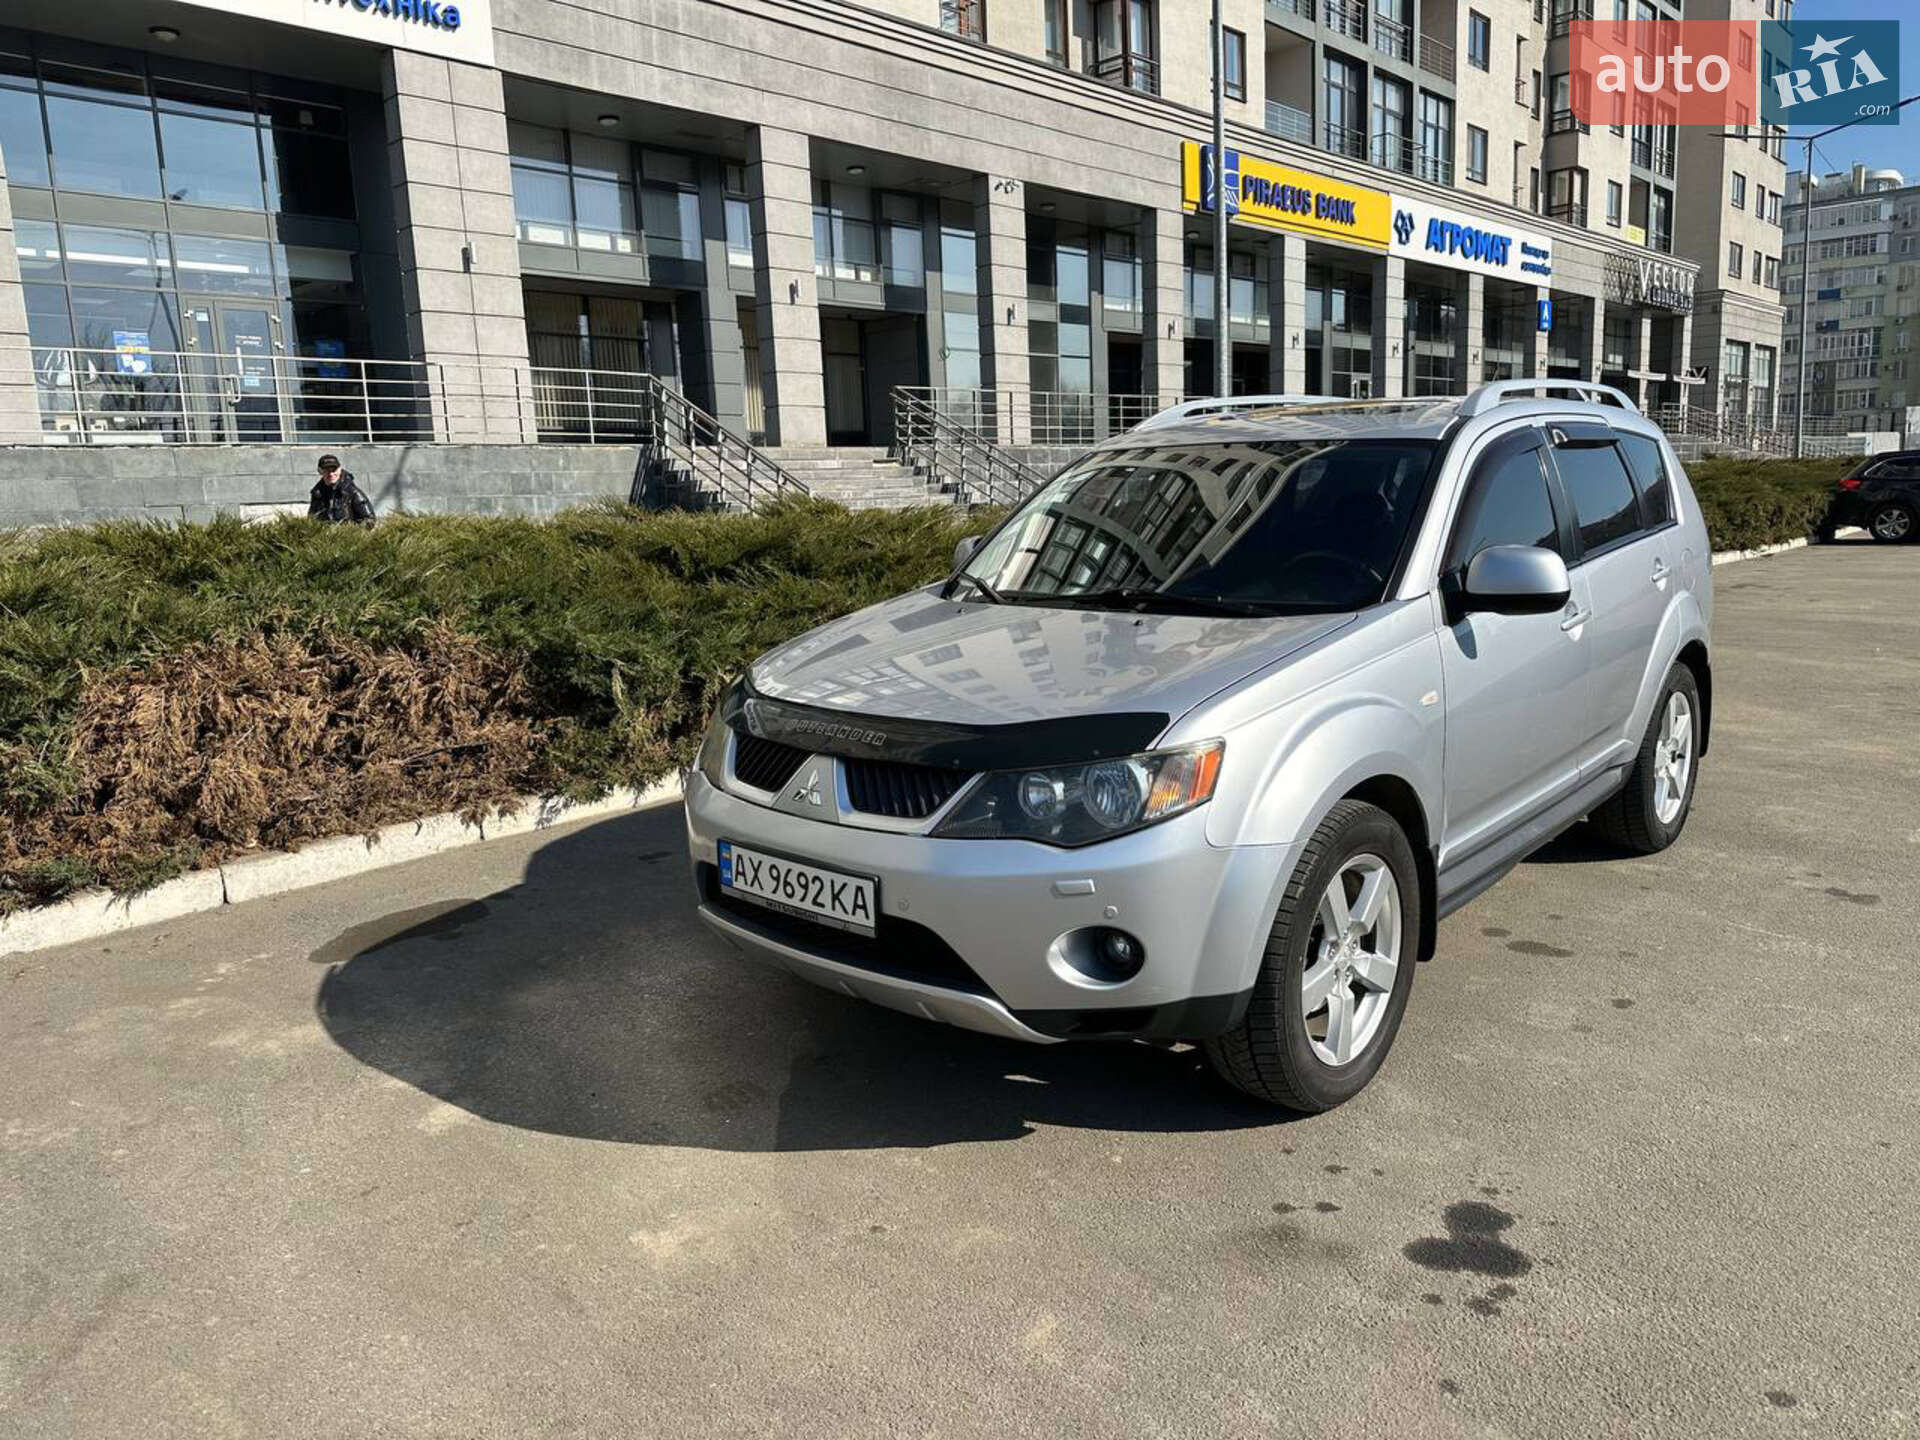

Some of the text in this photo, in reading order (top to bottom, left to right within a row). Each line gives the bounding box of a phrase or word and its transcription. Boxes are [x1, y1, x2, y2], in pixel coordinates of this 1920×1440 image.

[1242, 174, 1357, 227] PIRAEUS BANK
[1425, 217, 1512, 268] АГРОМАТ
